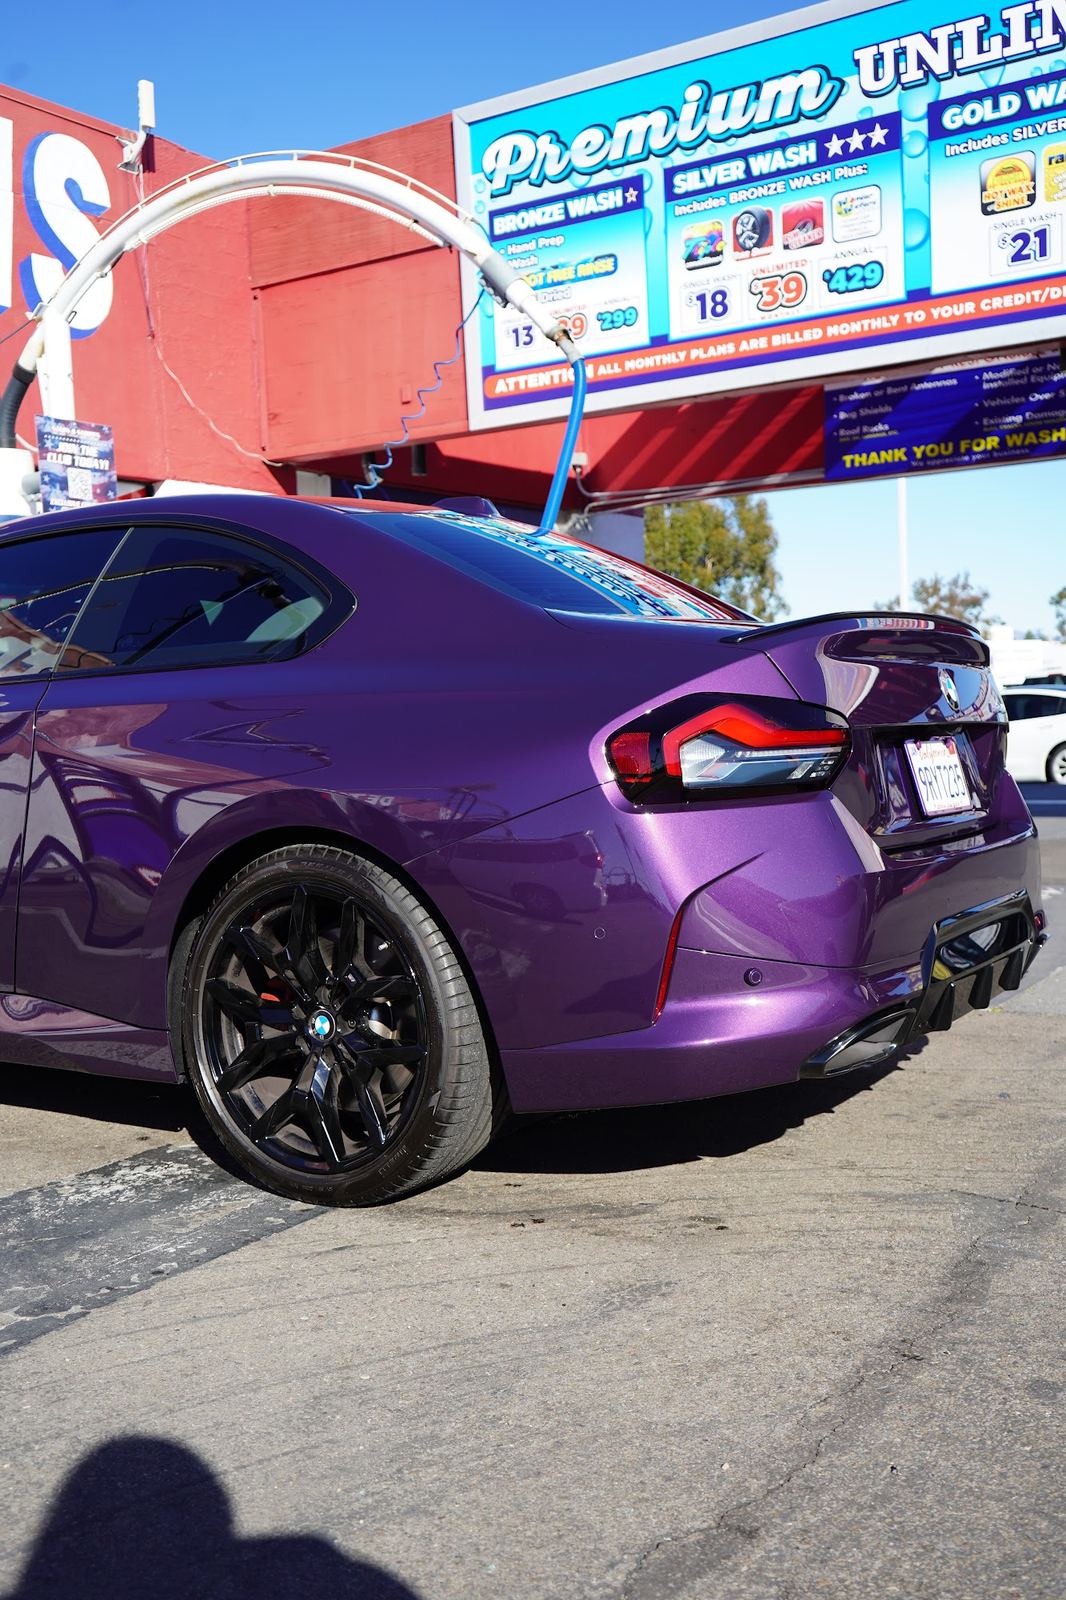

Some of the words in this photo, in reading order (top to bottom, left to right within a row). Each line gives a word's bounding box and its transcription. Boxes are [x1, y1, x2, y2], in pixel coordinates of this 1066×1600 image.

[481, 65, 843, 197] Premium
[942, 91, 1021, 131] GOLD
[945, 132, 1009, 157] Includes
[1012, 117, 1066, 142] SILVER
[673, 157, 747, 194] SILVER
[747, 139, 817, 176] WASH
[674, 195, 727, 217] Includes
[729, 180, 786, 204] BRONZE
[789, 169, 832, 190] WASH
[834, 163, 868, 180] Plus:
[493, 201, 566, 235] BRONZE
[566, 187, 623, 218] WASH
[507, 240, 536, 255] Hand
[538, 235, 565, 249] Prep
[752, 259, 808, 276] UNLIMITED
[597, 363, 622, 376] ALL
[624, 351, 687, 371] MONTHLY
[690, 342, 736, 360] PLANS
[739, 336, 768, 352] ARE
[771, 327, 823, 346] BILLED
[826, 314, 899, 337] MONTHLY
[904, 310, 926, 324] TO
[930, 301, 976, 319] YOUR
[980, 285, 1066, 311] CREDIT/D
[910, 378, 958, 391] Antennas
[1028, 392, 1056, 402] Over
[842, 447, 908, 469] THANK
[912, 441, 954, 460] YOU
[960, 435, 1000, 454] FOR
[1005, 427, 1066, 448] WASH
[918, 764, 965, 801] 9RYT235
